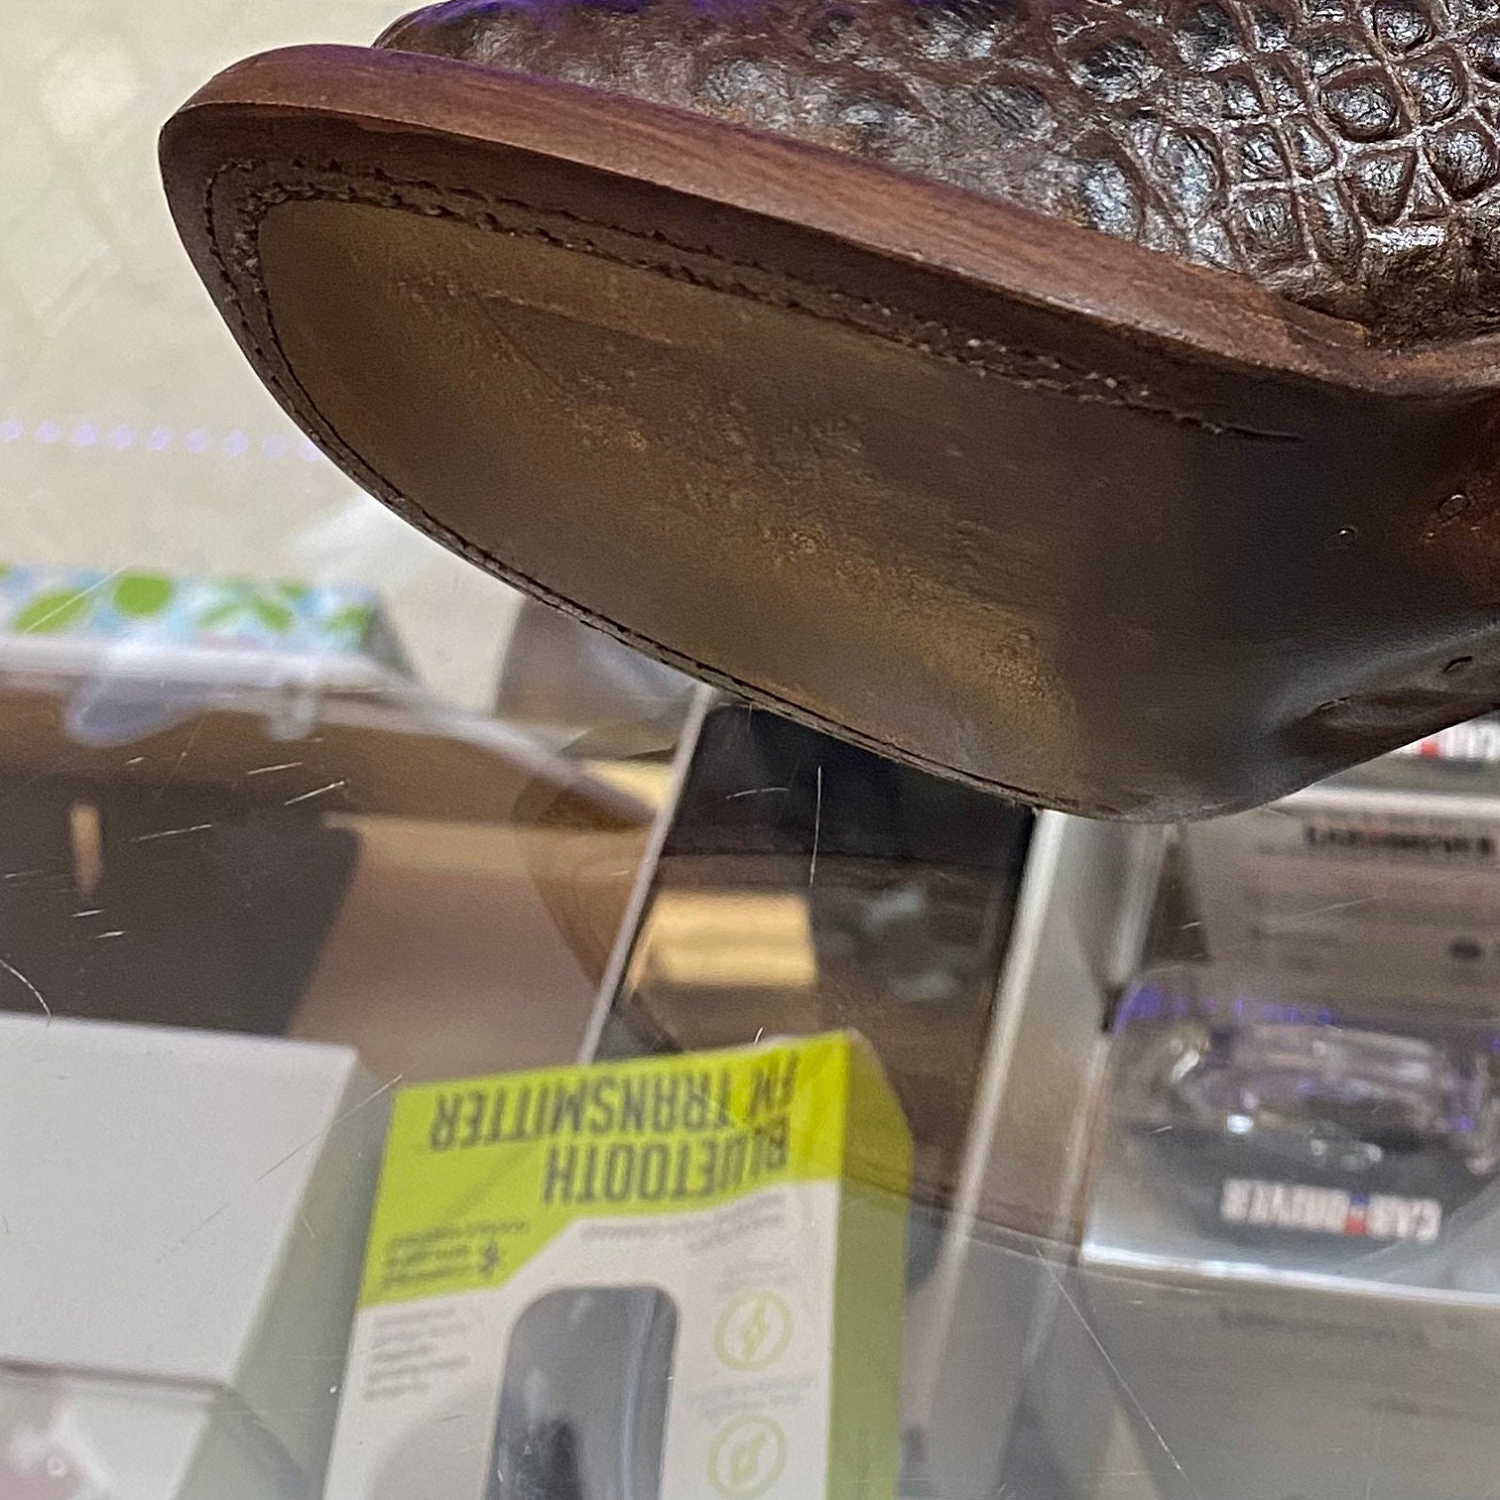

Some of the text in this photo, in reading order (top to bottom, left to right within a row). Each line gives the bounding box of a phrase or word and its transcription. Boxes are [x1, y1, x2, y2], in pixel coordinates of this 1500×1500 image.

[428, 1053, 799, 1154] FM TRANSMITTER
[542, 1117, 790, 1208] BLUETOOTH
